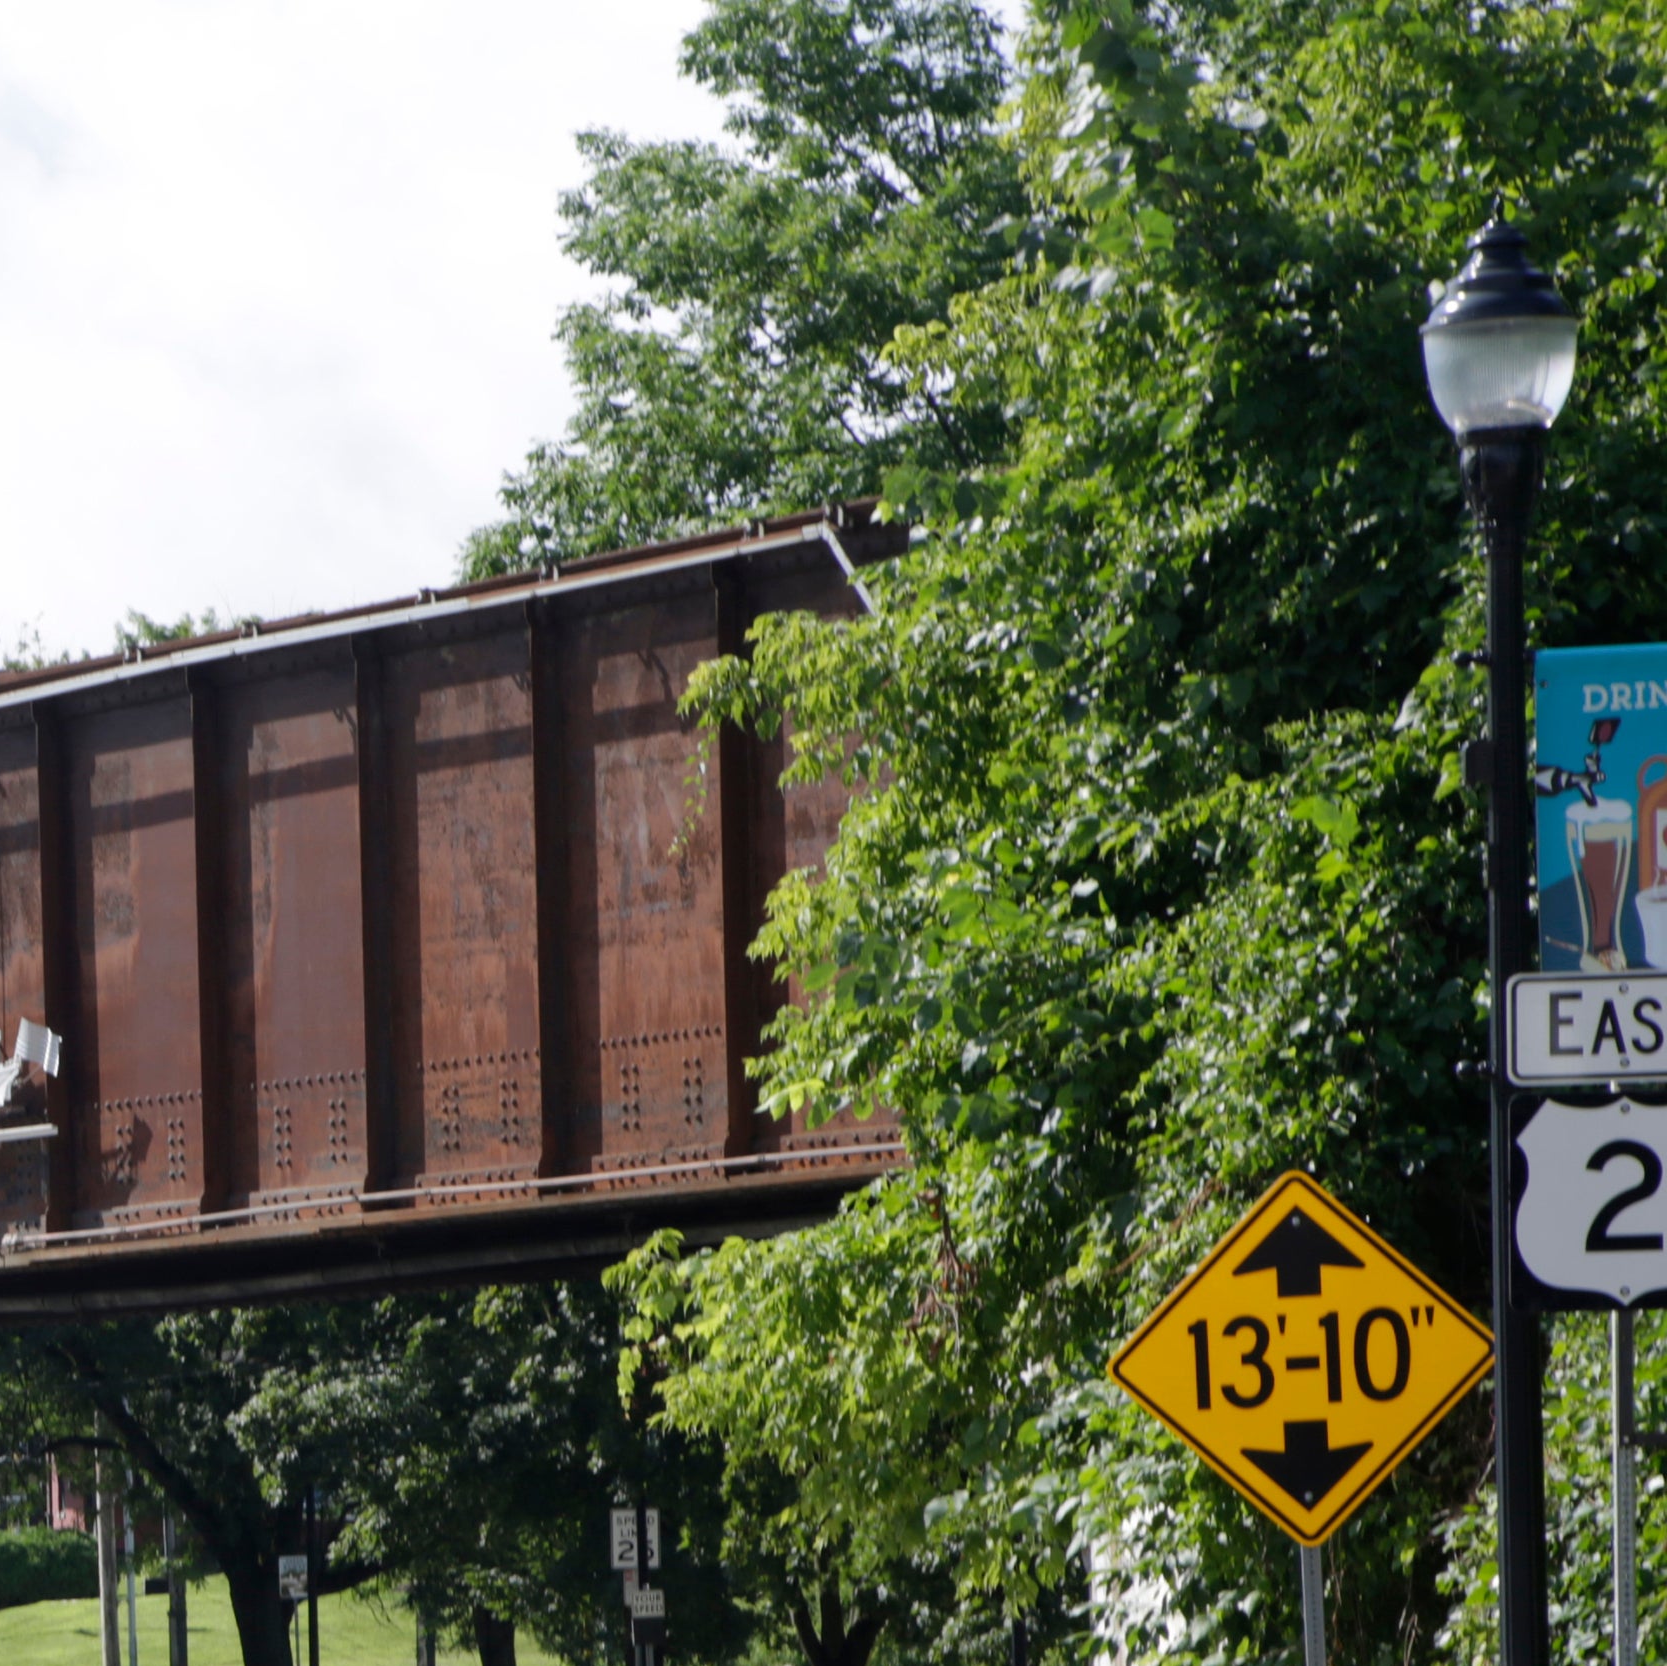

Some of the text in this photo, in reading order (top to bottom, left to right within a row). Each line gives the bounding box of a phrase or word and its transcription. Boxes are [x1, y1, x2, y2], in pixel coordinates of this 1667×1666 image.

[1549, 990, 1664, 1056] EAS
[1585, 1139, 1664, 1252] 2
[616, 1515, 655, 1526] SPED
